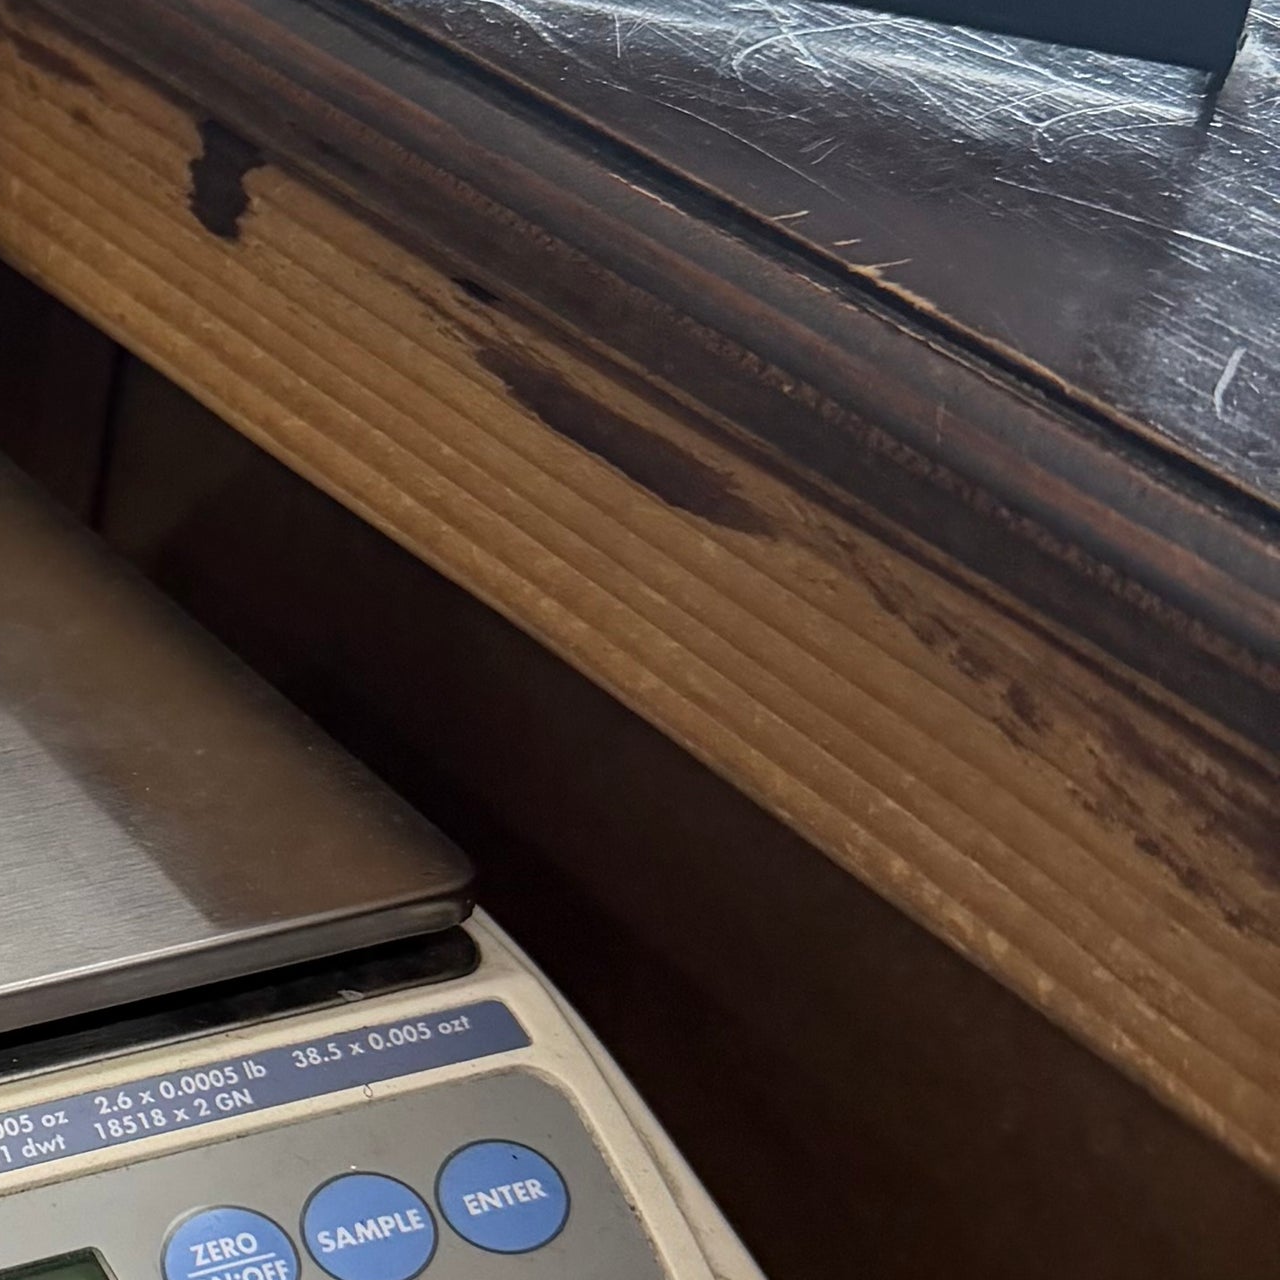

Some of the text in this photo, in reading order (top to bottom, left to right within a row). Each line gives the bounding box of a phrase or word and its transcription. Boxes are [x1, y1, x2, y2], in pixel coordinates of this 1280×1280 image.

[41, 1109, 69, 1127] oz
[94, 1090, 133, 1116] 2.6
[139, 1089, 155, 1105] x
[159, 1066, 239, 1100] 0.0005
[242, 1060, 267, 1081] lb
[291, 1043, 343, 1070] 38.5
[348, 1041, 365, 1057] x
[368, 1021, 432, 1052] 0.005
[437, 1015, 471, 1035] ozt
[21, 1133, 67, 1159] dwt
[93, 1108, 167, 1141] 18518
[172, 1107, 189, 1122] x
[197, 1096, 211, 1118] 2
[215, 1088, 253, 1112] GN
[462, 1178, 548, 1216] ENTER
[189, 1231, 259, 1267] ZERO
[316, 1208, 425, 1254] SAMPLE
